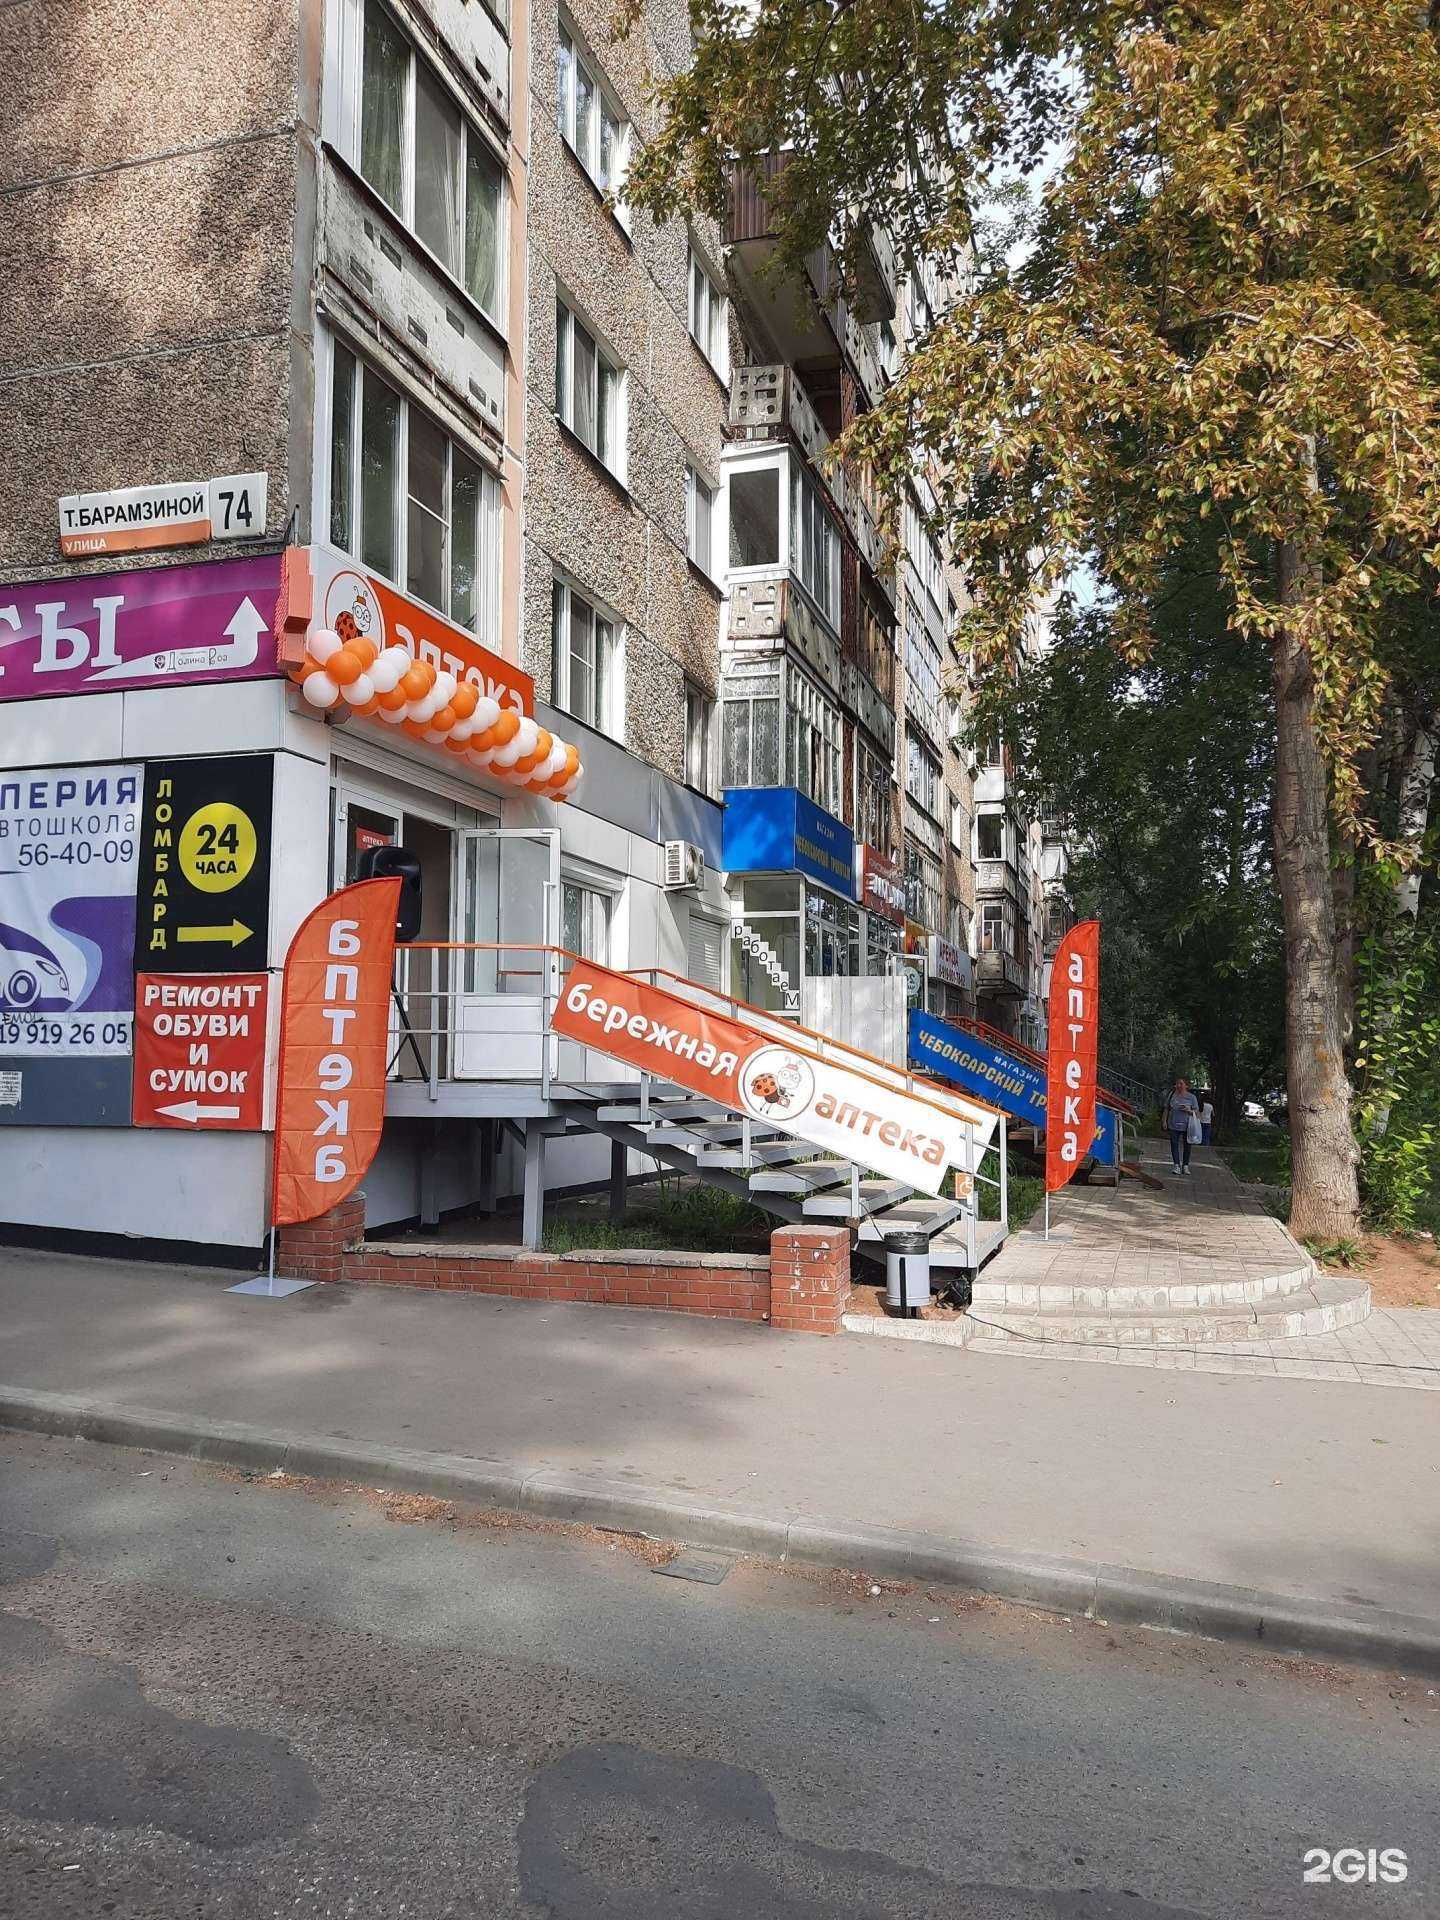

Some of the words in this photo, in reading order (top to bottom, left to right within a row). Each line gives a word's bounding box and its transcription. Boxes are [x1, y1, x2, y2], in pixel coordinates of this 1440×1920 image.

[64, 491, 204, 528] Т.БАРАМЗИНОЙ
[218, 489, 252, 529] 74
[65, 538, 107, 553] УЛИЦА
[18, 839, 134, 867] 56-40-09
[196, 823, 240, 856] 24
[150, 779, 173, 950] ЛОМБАРД
[195, 860, 238, 875] ЧАСА
[144, 984, 262, 1008] РЕМОНТ
[27, 1022, 63, 1044] 919
[69, 1022, 95, 1044] 26
[102, 1022, 128, 1044] 05
[153, 1013, 249, 1037] ОБУВИ
[566, 982, 741, 1078] бережная
[189, 1043, 209, 1066] И
[918, 1029, 1025, 1097] ЧЕБОКСАРСКИЙ
[1061, 952, 1084, 1162] аптека
[149, 1068, 248, 1093] СУМОК
[993, 1055, 1041, 1086] МАГАЗИН
[815, 1091, 947, 1166] аптека
